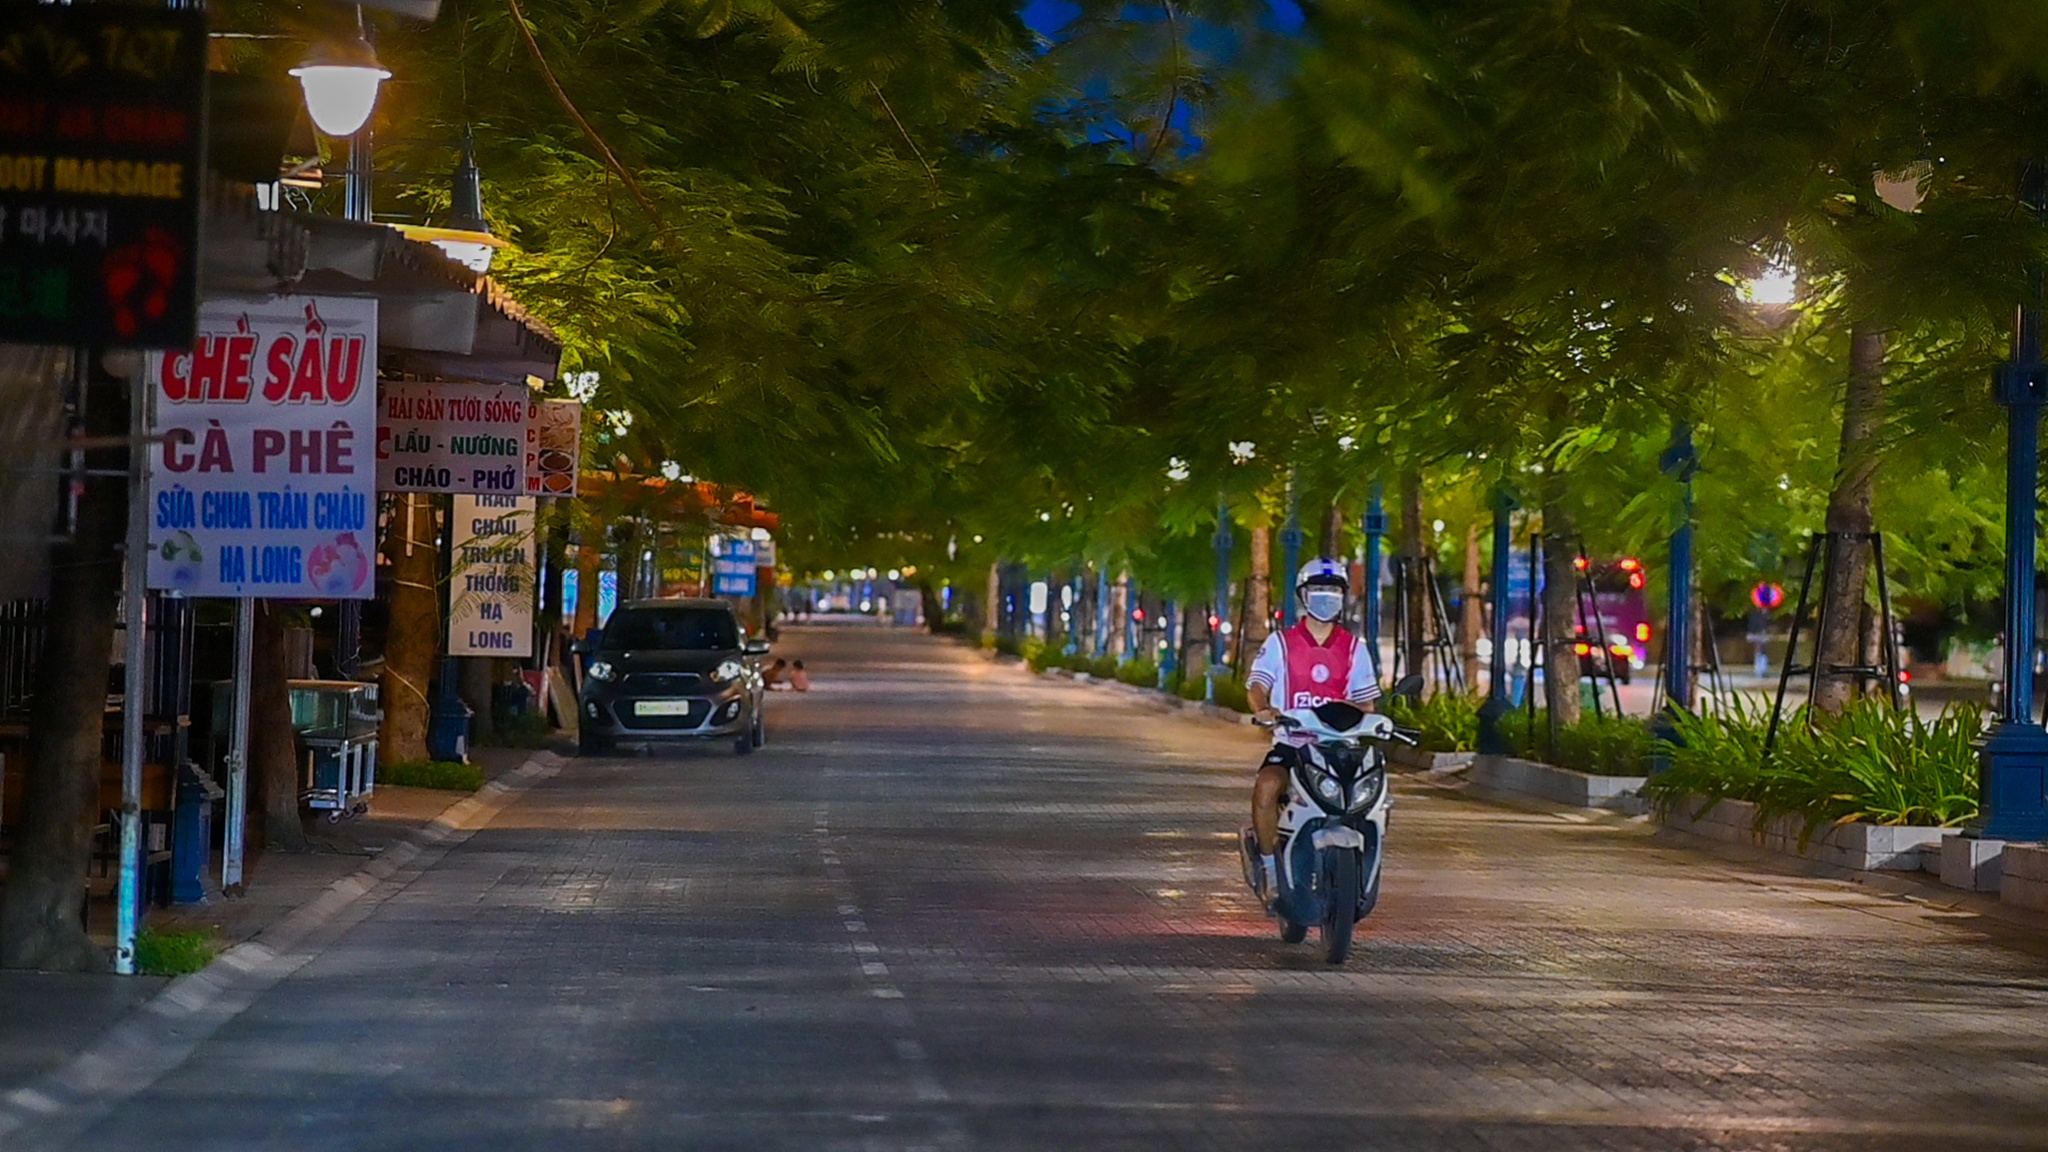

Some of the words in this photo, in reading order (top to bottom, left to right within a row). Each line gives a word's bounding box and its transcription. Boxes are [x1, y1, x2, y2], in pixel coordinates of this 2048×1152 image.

[54, 156, 184, 199] MASSAGE
[161, 312, 258, 402] CHÈ
[263, 299, 365, 403] SẦU
[388, 388, 413, 419] HẢI
[417, 389, 445, 420] SẢN
[449, 396, 481, 422] TƯƠI
[485, 390, 521, 423] SỐNG
[163, 419, 234, 473] CÀ
[253, 421, 354, 473] PHÊ
[451, 433, 518, 456] NƯỚNG
[394, 461, 451, 487] CHÁO
[473, 464, 516, 490] PHỞ
[157, 484, 195, 529] SỮA
[202, 491, 252, 529] CHUA
[258, 484, 308, 529] TRÂN
[315, 485, 365, 530] CHÂU
[220, 546, 245, 592] HẠ
[252, 546, 302, 583] LONG
[481, 603, 502, 624] HẠ
[469, 631, 513, 649] LONG
